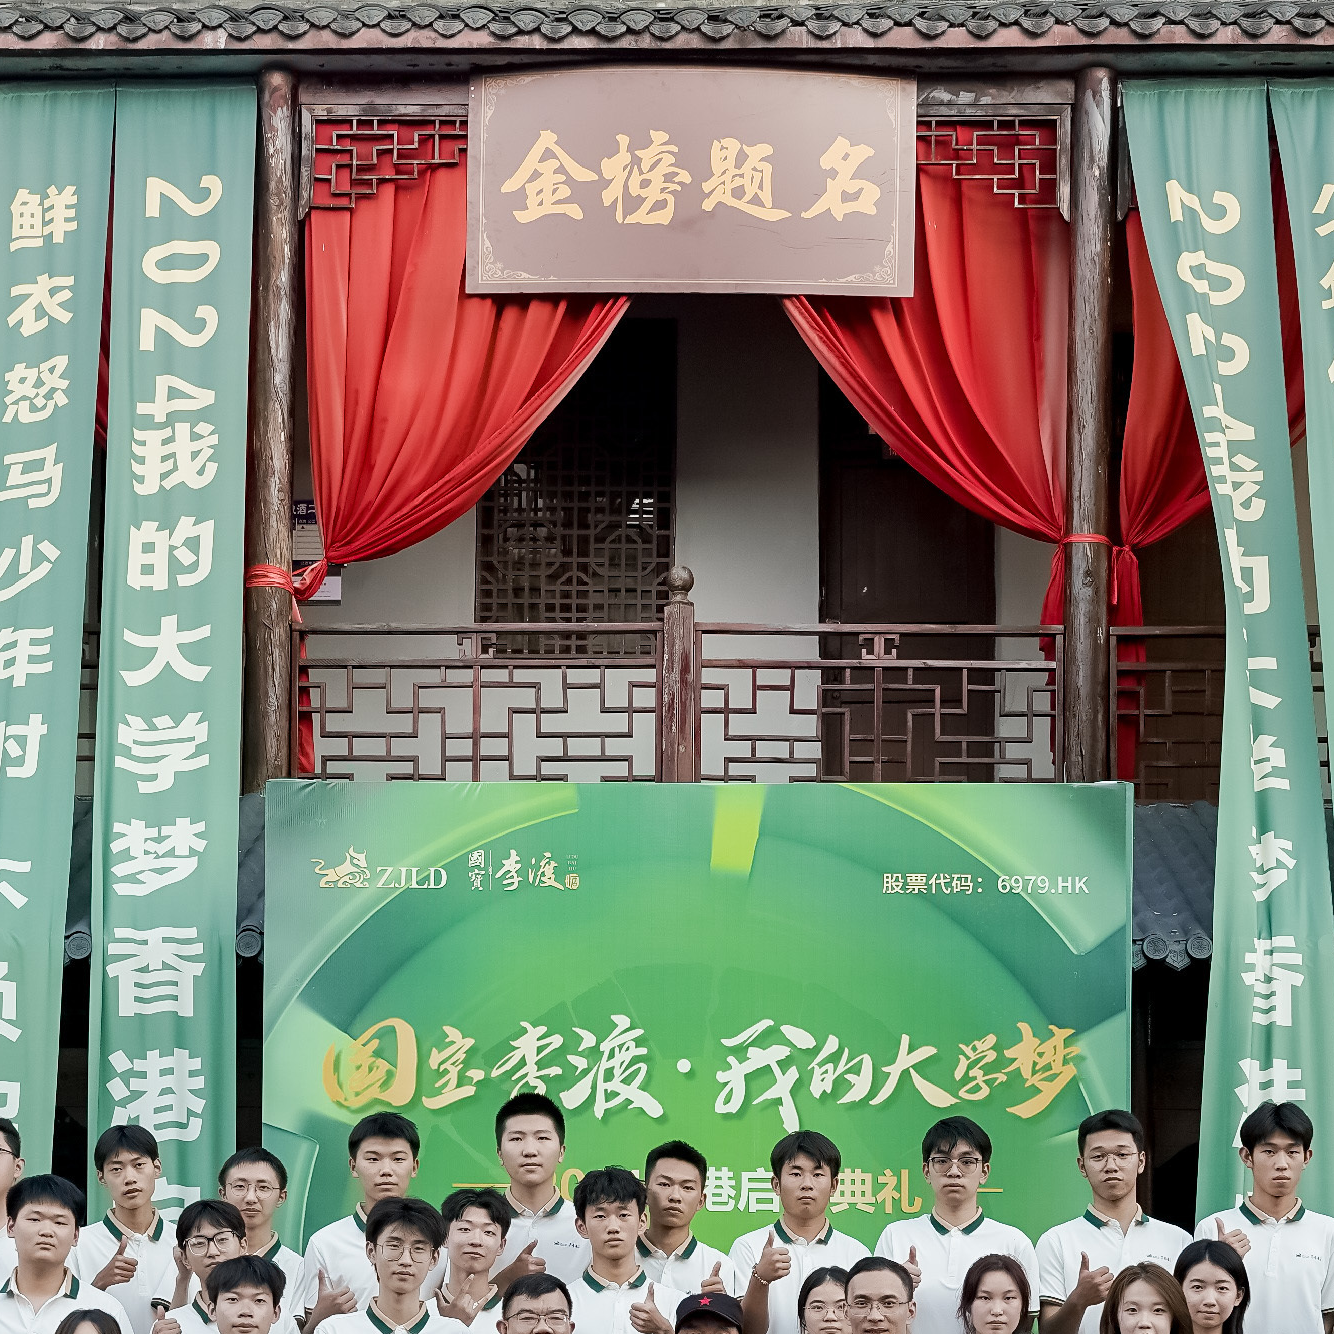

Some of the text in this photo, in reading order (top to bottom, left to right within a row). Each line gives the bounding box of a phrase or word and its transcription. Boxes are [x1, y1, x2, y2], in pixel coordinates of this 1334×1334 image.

[501, 130, 881, 226] 金榜题名
[105, 176, 225, 1226] 2024我的大学梦香港
[376, 867, 448, 889] ZJLD
[495, 849, 565, 891] 李渡
